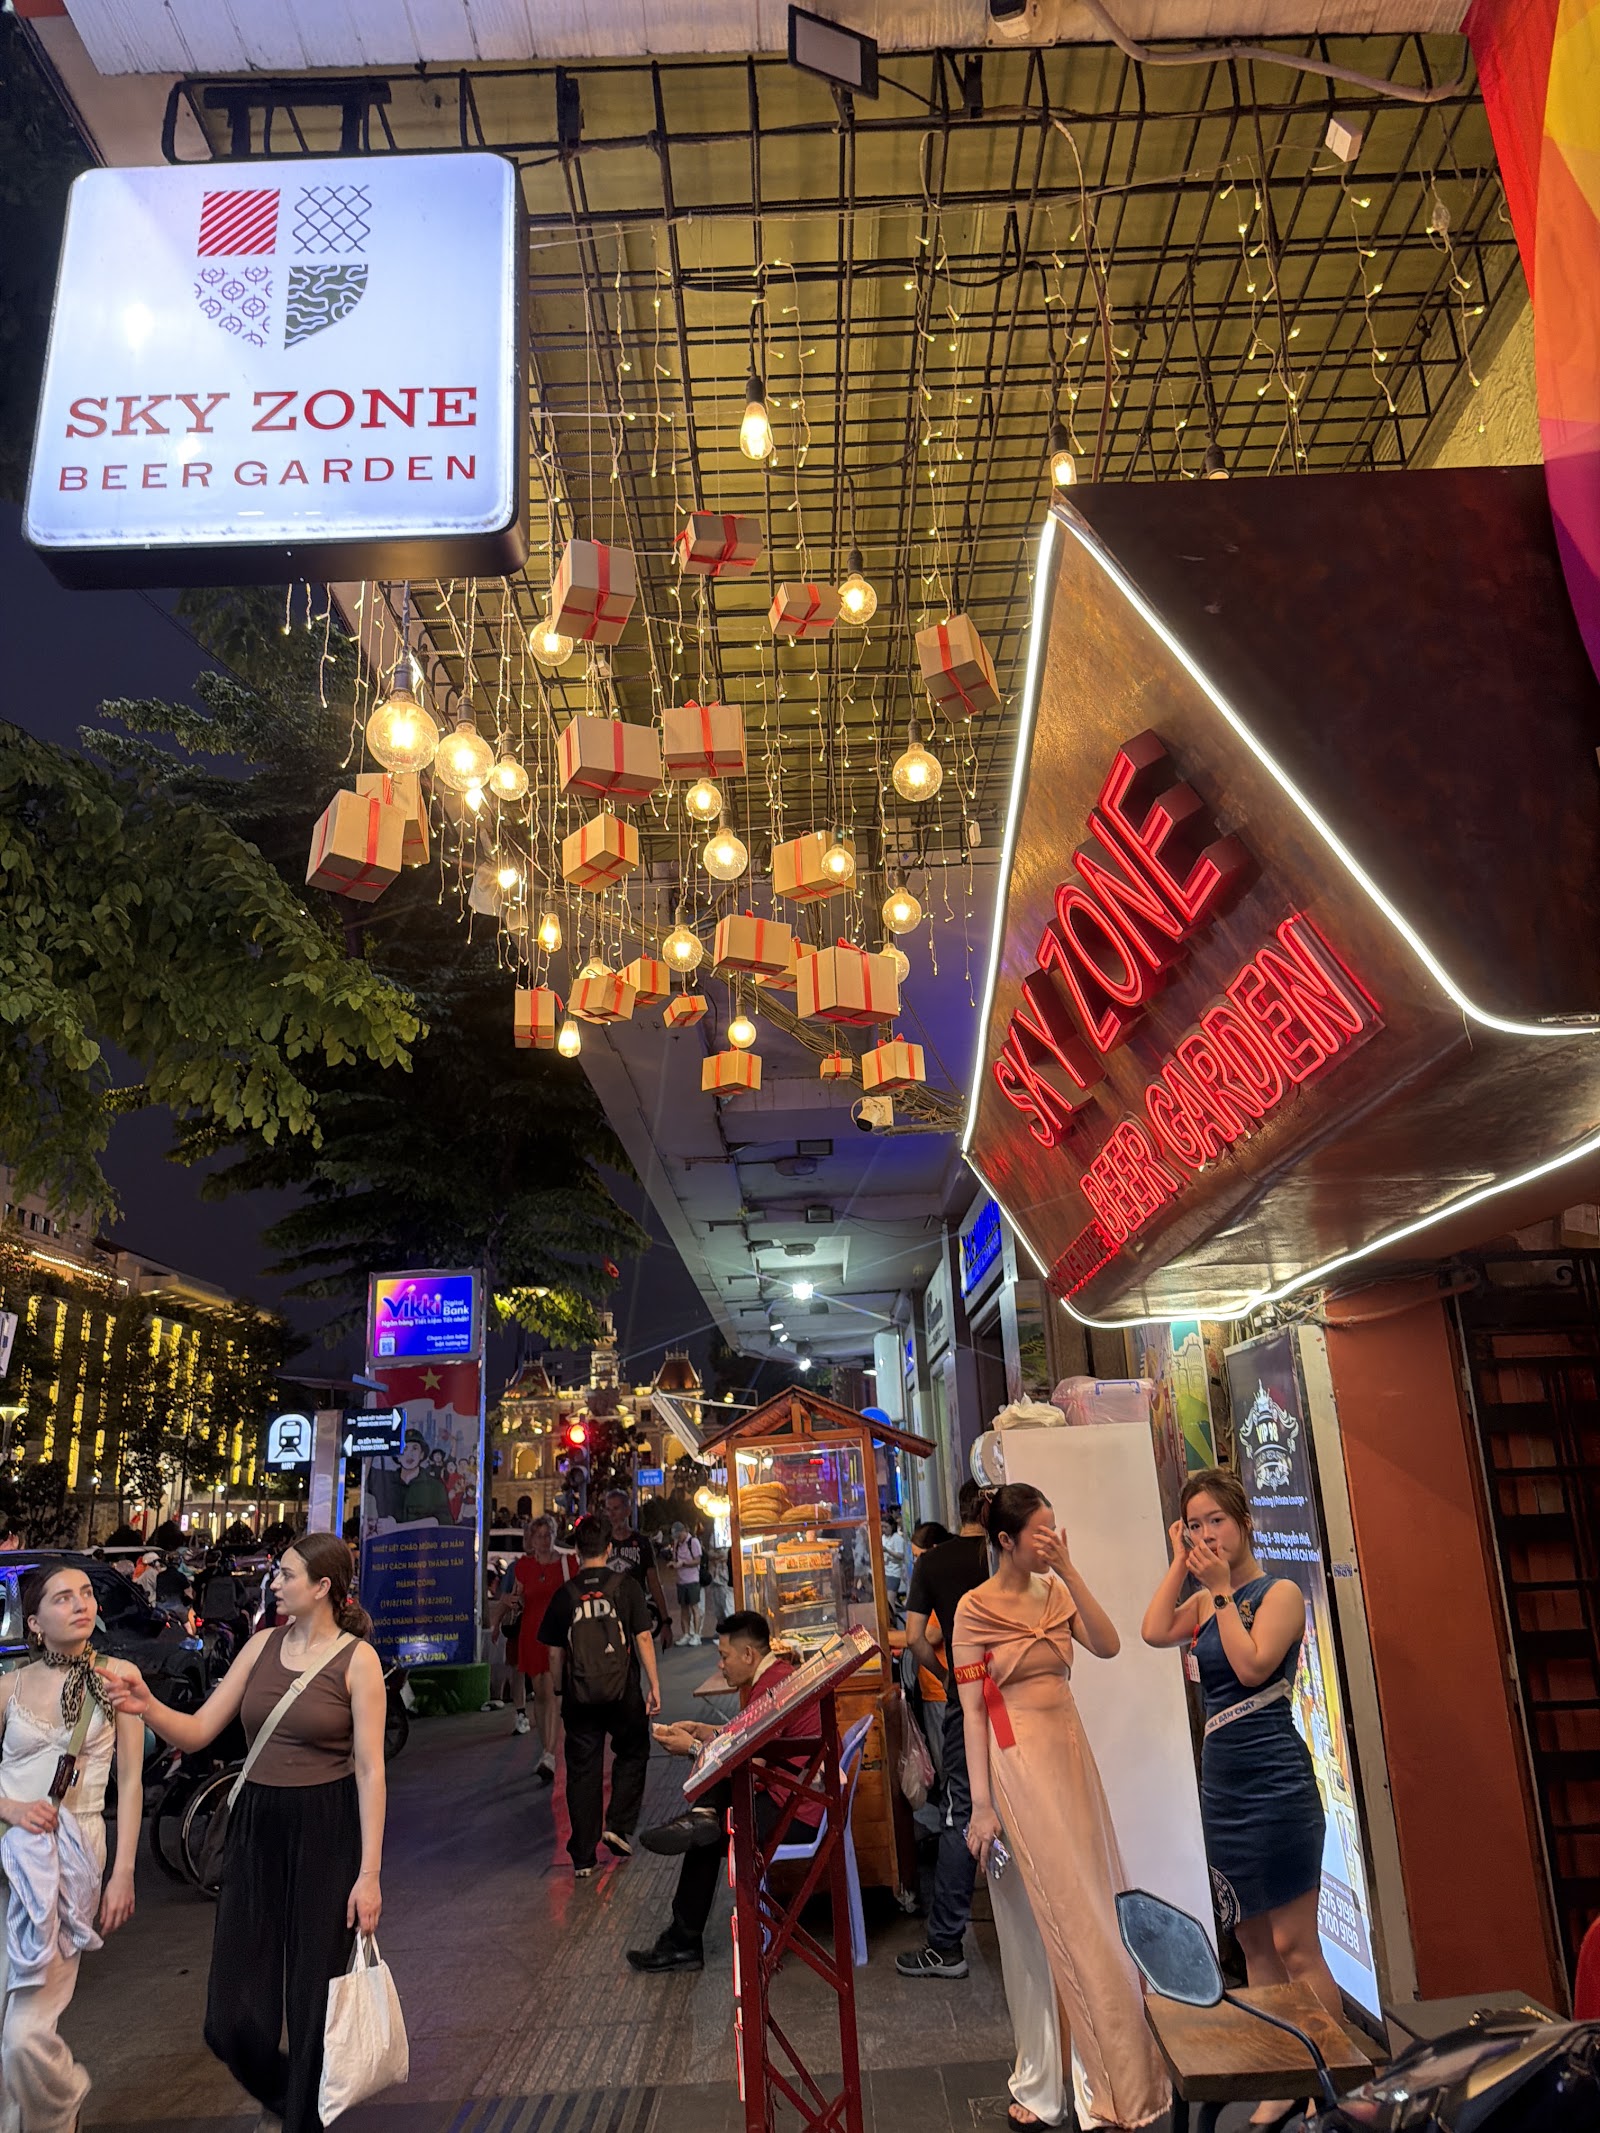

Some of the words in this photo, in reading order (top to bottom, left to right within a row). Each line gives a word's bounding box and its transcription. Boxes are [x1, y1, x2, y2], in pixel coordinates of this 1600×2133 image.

[65, 392, 230, 439] SKY
[252, 386, 478, 432] ZONE
[58, 461, 214, 492] BEER
[234, 454, 477, 487] GARDEN
[1035, 742, 1223, 1053] ZONE
[993, 978, 1088, 1149] SKY
[1079, 1117, 1179, 1244] BEER
[1145, 911, 1366, 1171] GARDEN
[381, 1284, 442, 1319] Vikki
[443, 1305, 470, 1316] Bank
[1256, 1423, 1269, 1444] VIP
[1268, 1421, 1279, 1443] 98
